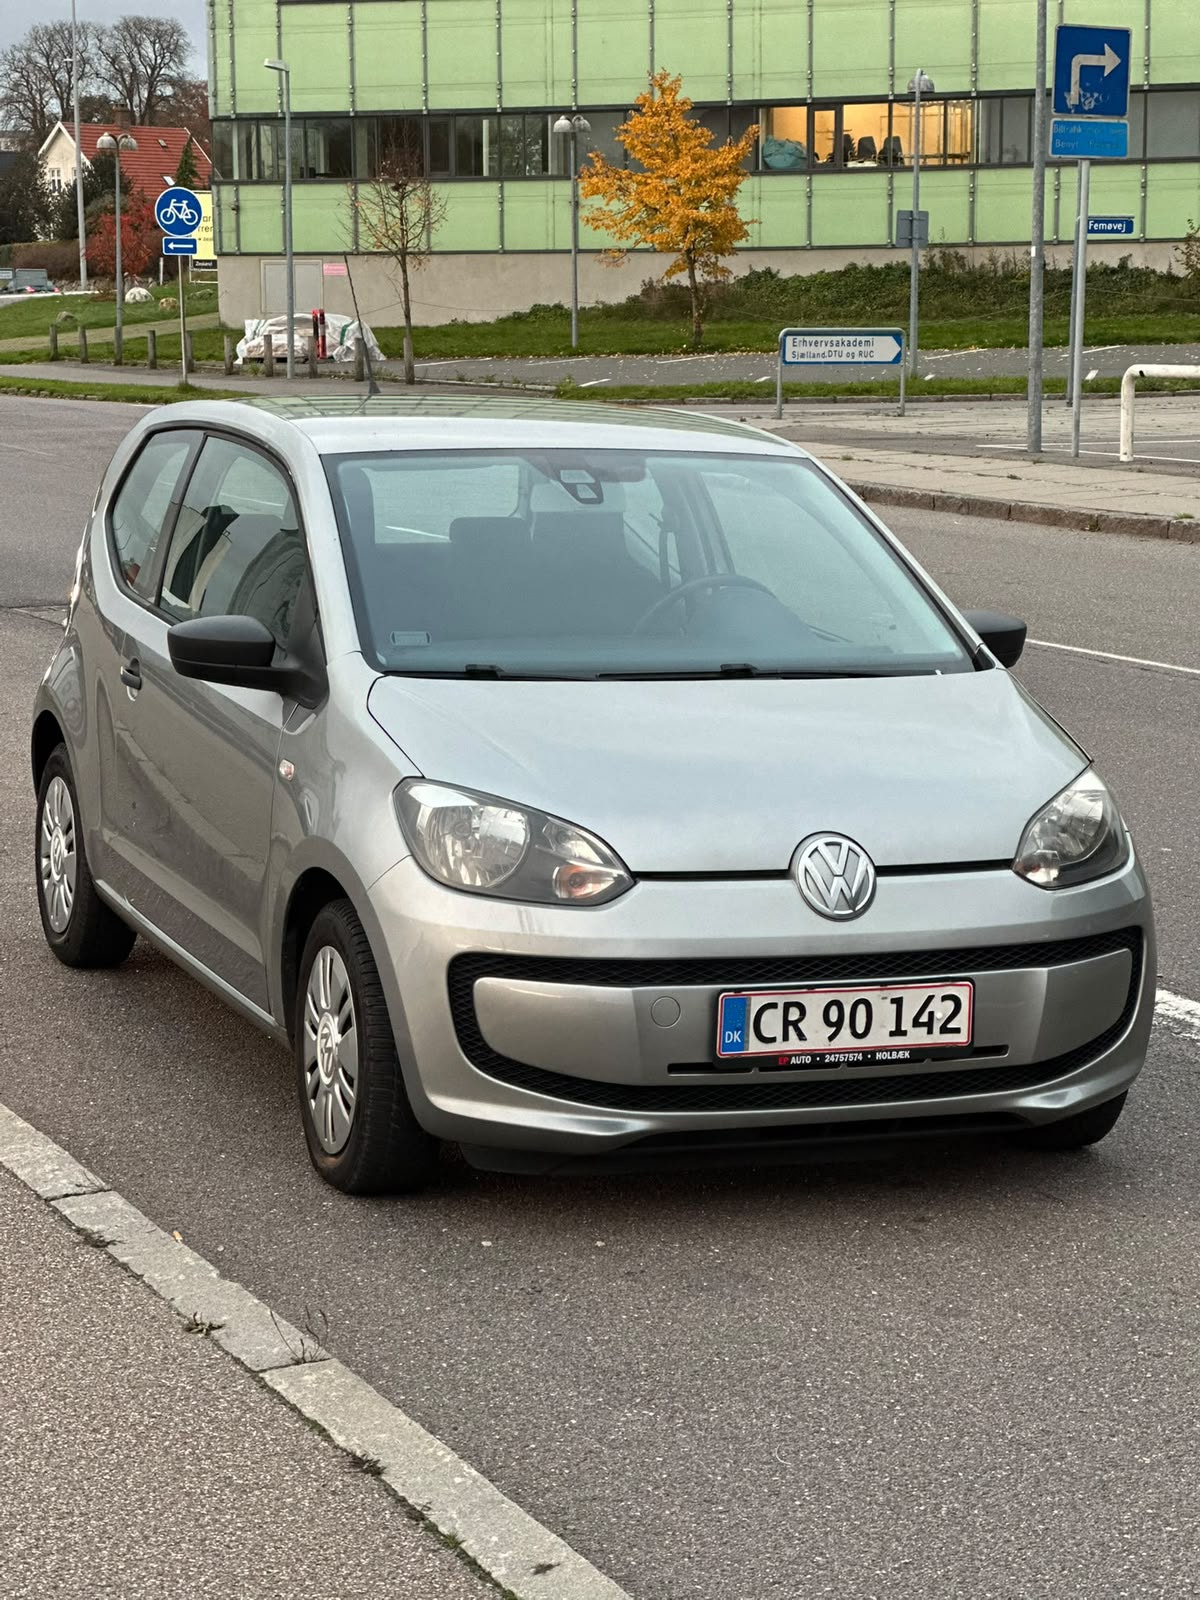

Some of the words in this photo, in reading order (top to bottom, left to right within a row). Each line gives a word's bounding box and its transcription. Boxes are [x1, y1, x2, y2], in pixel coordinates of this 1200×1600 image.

[1088, 220, 1126, 233] Femøvej
[792, 337, 875, 348] Erhvervsakademi
[846, 352, 856, 360] og
[858, 350, 875, 358] RUC
[725, 1030, 742, 1044] DK
[752, 1001, 808, 1045] CR
[822, 998, 874, 1043] 90
[888, 993, 963, 1038] 142
[790, 1055, 812, 1065] AUTO
[824, 1052, 864, 1063] 24757574
[875, 1050, 911, 1061] HOLBÆK
